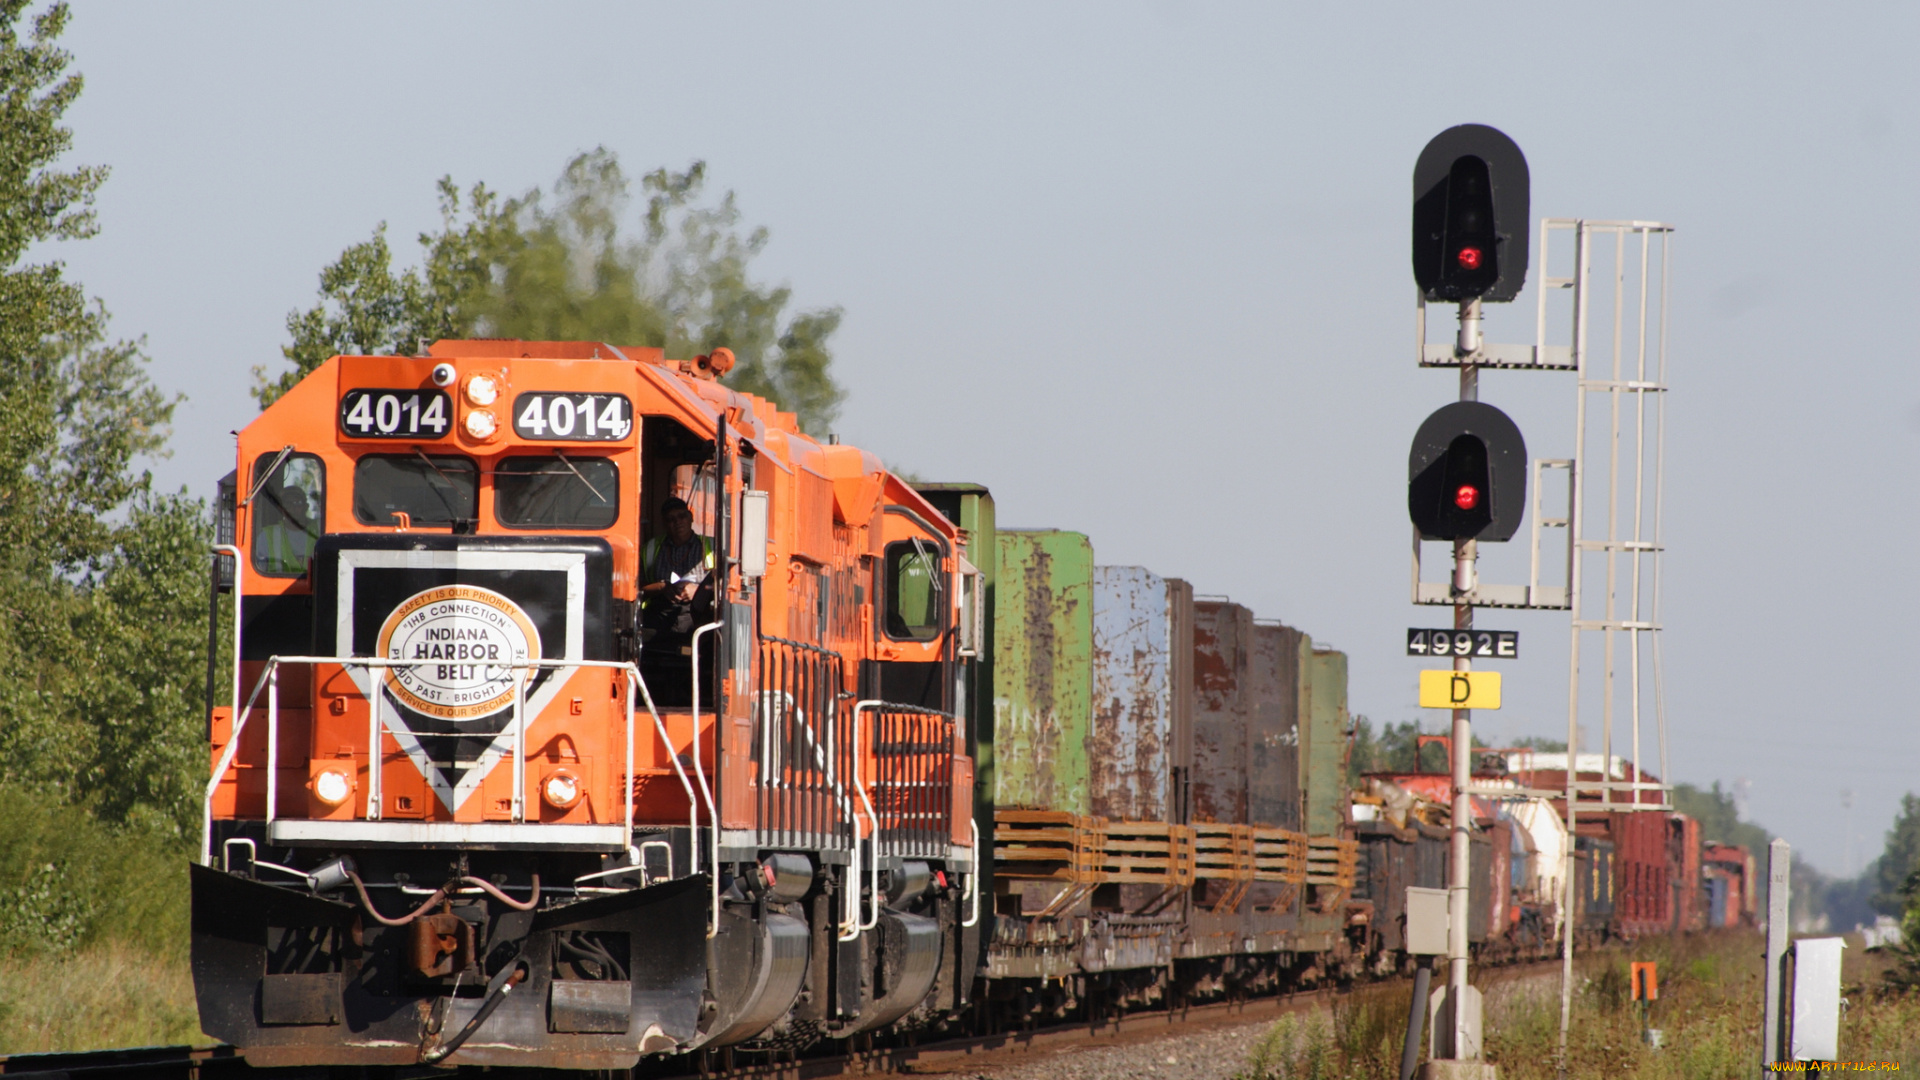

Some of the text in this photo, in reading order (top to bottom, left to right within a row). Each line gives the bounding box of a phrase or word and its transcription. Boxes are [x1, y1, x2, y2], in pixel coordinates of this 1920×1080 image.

[346, 394, 447, 433] 4014
[518, 396, 626, 436] 4014
[399, 589, 518, 617] SAFETY IS OUR PRIORITY
[425, 628, 489, 641] INDIANA
[1409, 631, 1515, 656] 4992E
[416, 643, 499, 659] HARBOR
[437, 664, 476, 680] BELT
[396, 688, 431, 713] SERVICE
[434, 707, 444, 716] IS
[447, 707, 468, 717] OUR
[416, 684, 442, 701] PAST
[454, 685, 497, 703] BRIGHT
[1450, 676, 1471, 703] D
